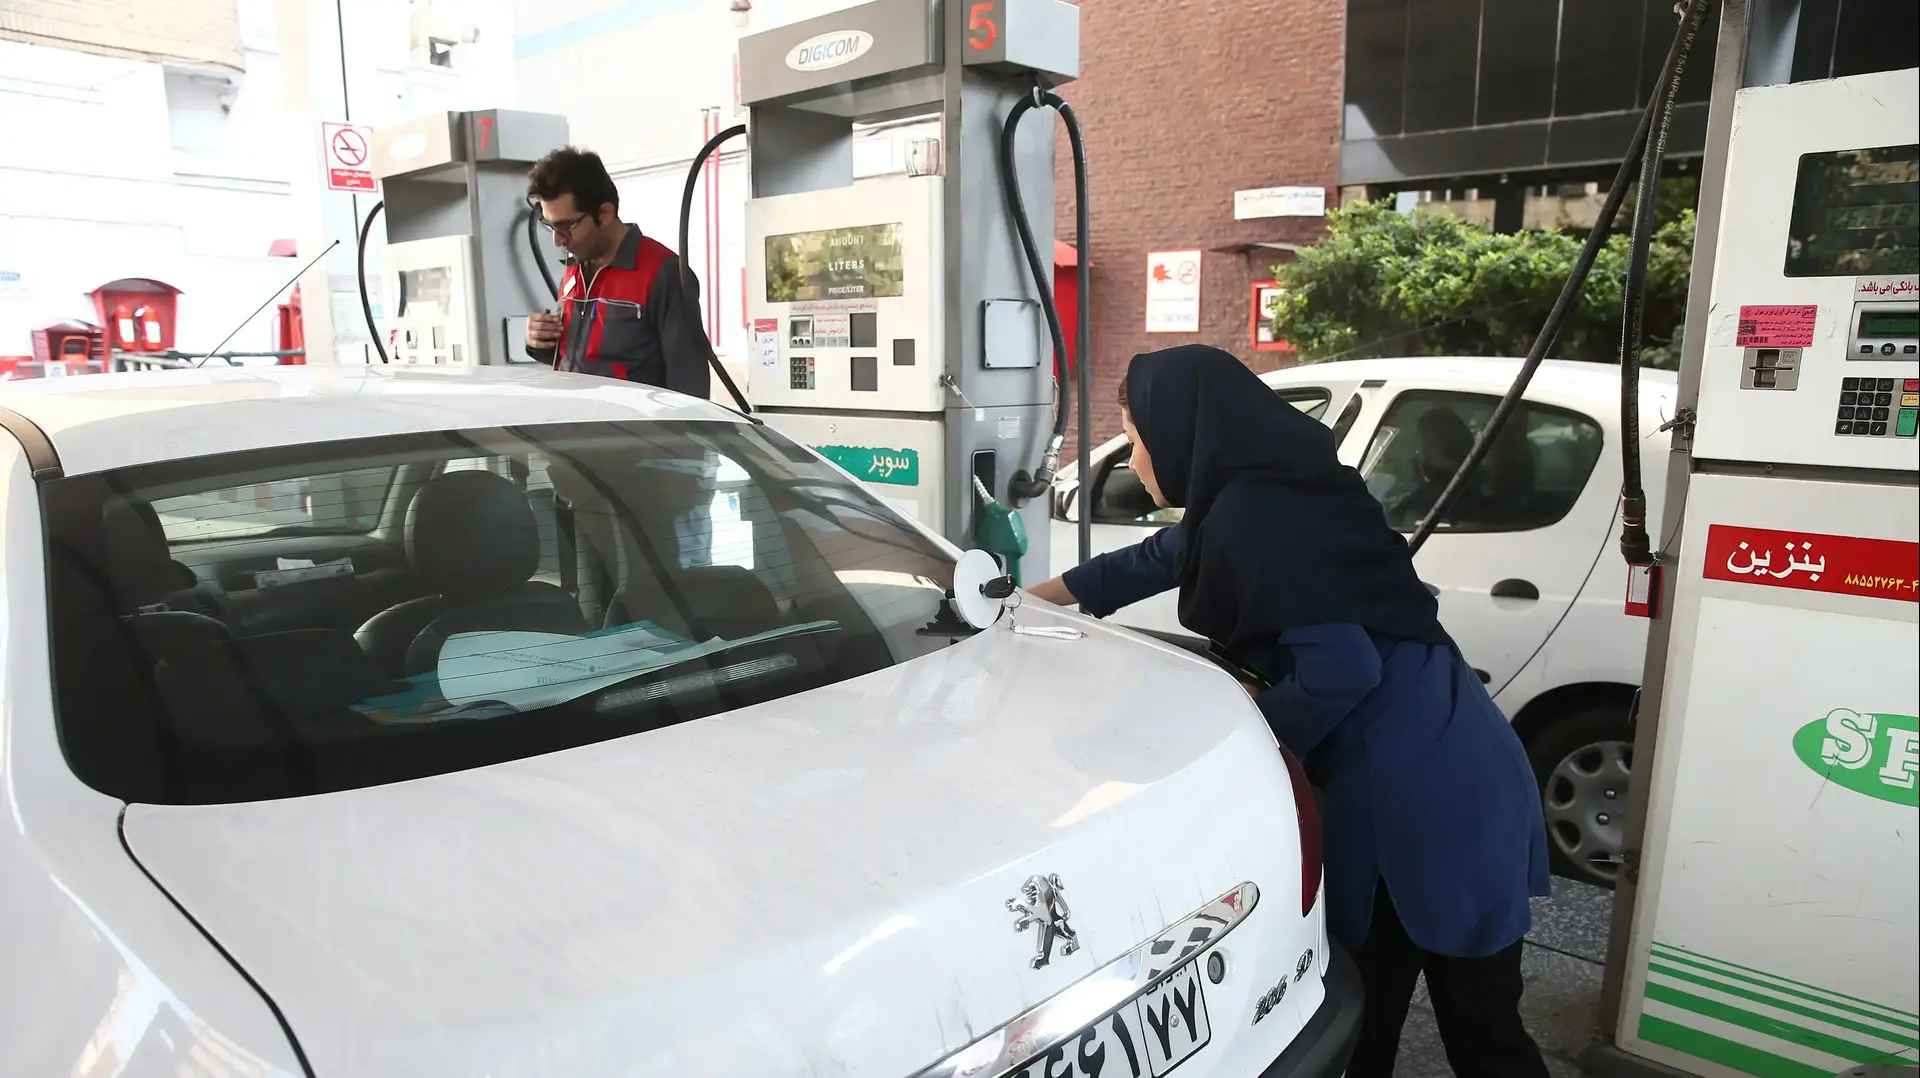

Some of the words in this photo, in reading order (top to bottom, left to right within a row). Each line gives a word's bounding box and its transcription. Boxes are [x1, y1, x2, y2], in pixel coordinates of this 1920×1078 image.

[968, 3, 996, 50] 5
[798, 34, 860, 66] DIGICOM
[476, 117, 494, 150] 7
[830, 235, 864, 247] AMOUNT
[828, 260, 864, 271] LITERS
[828, 284, 864, 294] PRICE/LITER
[868, 455, 910, 478] سوپر
[1727, 542, 1825, 582] بنزین
[1844, 573, 1919, 592] ۸۸۵۵۲۷۶۳-۴
[1251, 974, 1288, 1026] 206
[1147, 976, 1197, 1061] ۷۷
